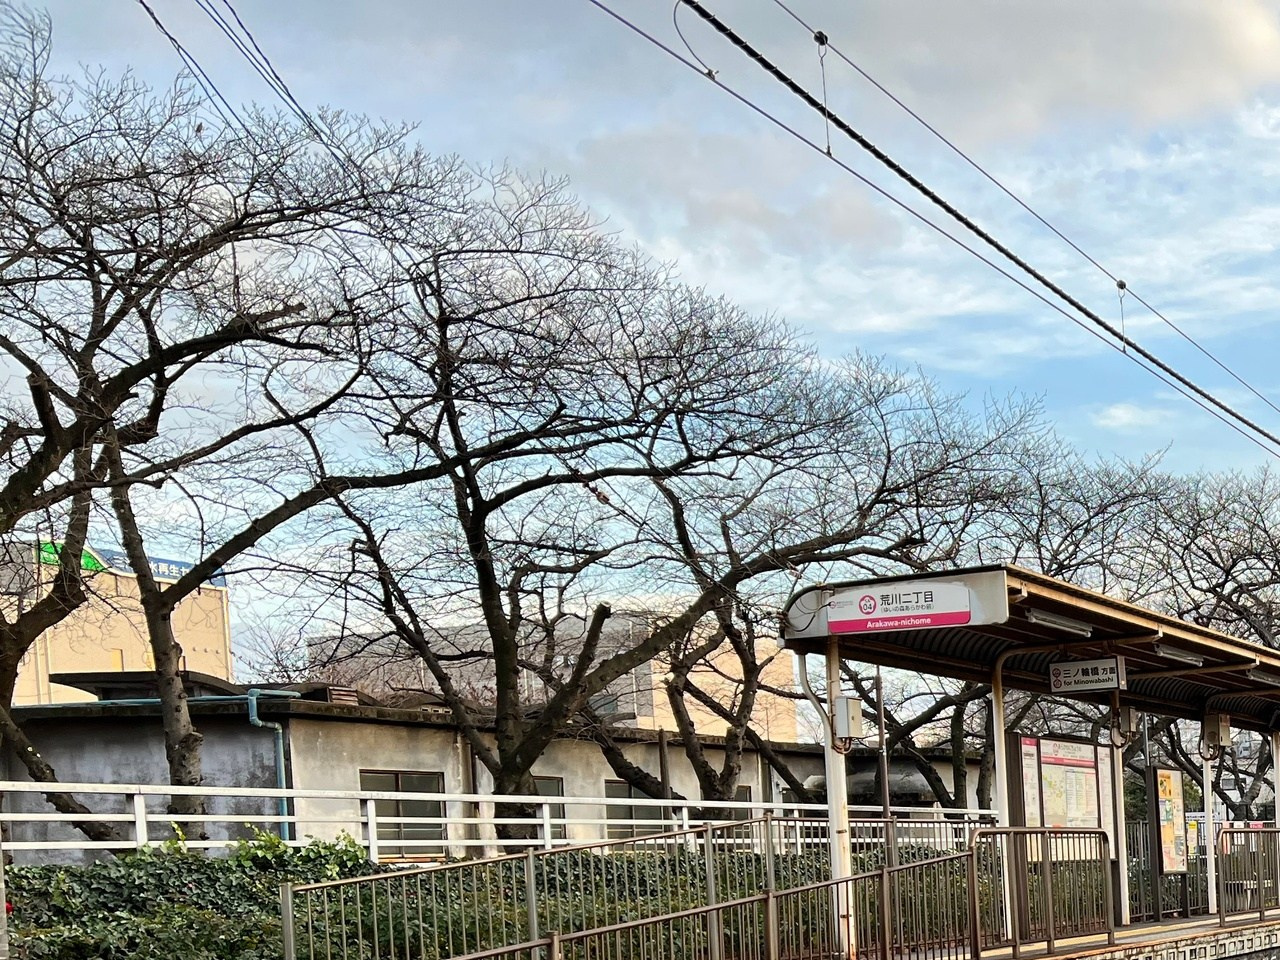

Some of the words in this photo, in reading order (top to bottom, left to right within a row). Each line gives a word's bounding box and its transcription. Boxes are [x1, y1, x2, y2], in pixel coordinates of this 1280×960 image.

[880, 590, 934, 606] 荒川二丁目
[862, 603, 873, 611] 04
[866, 616, 932, 629] Arakawa-nichome
[1074, 677, 1114, 686] Minowabashi
